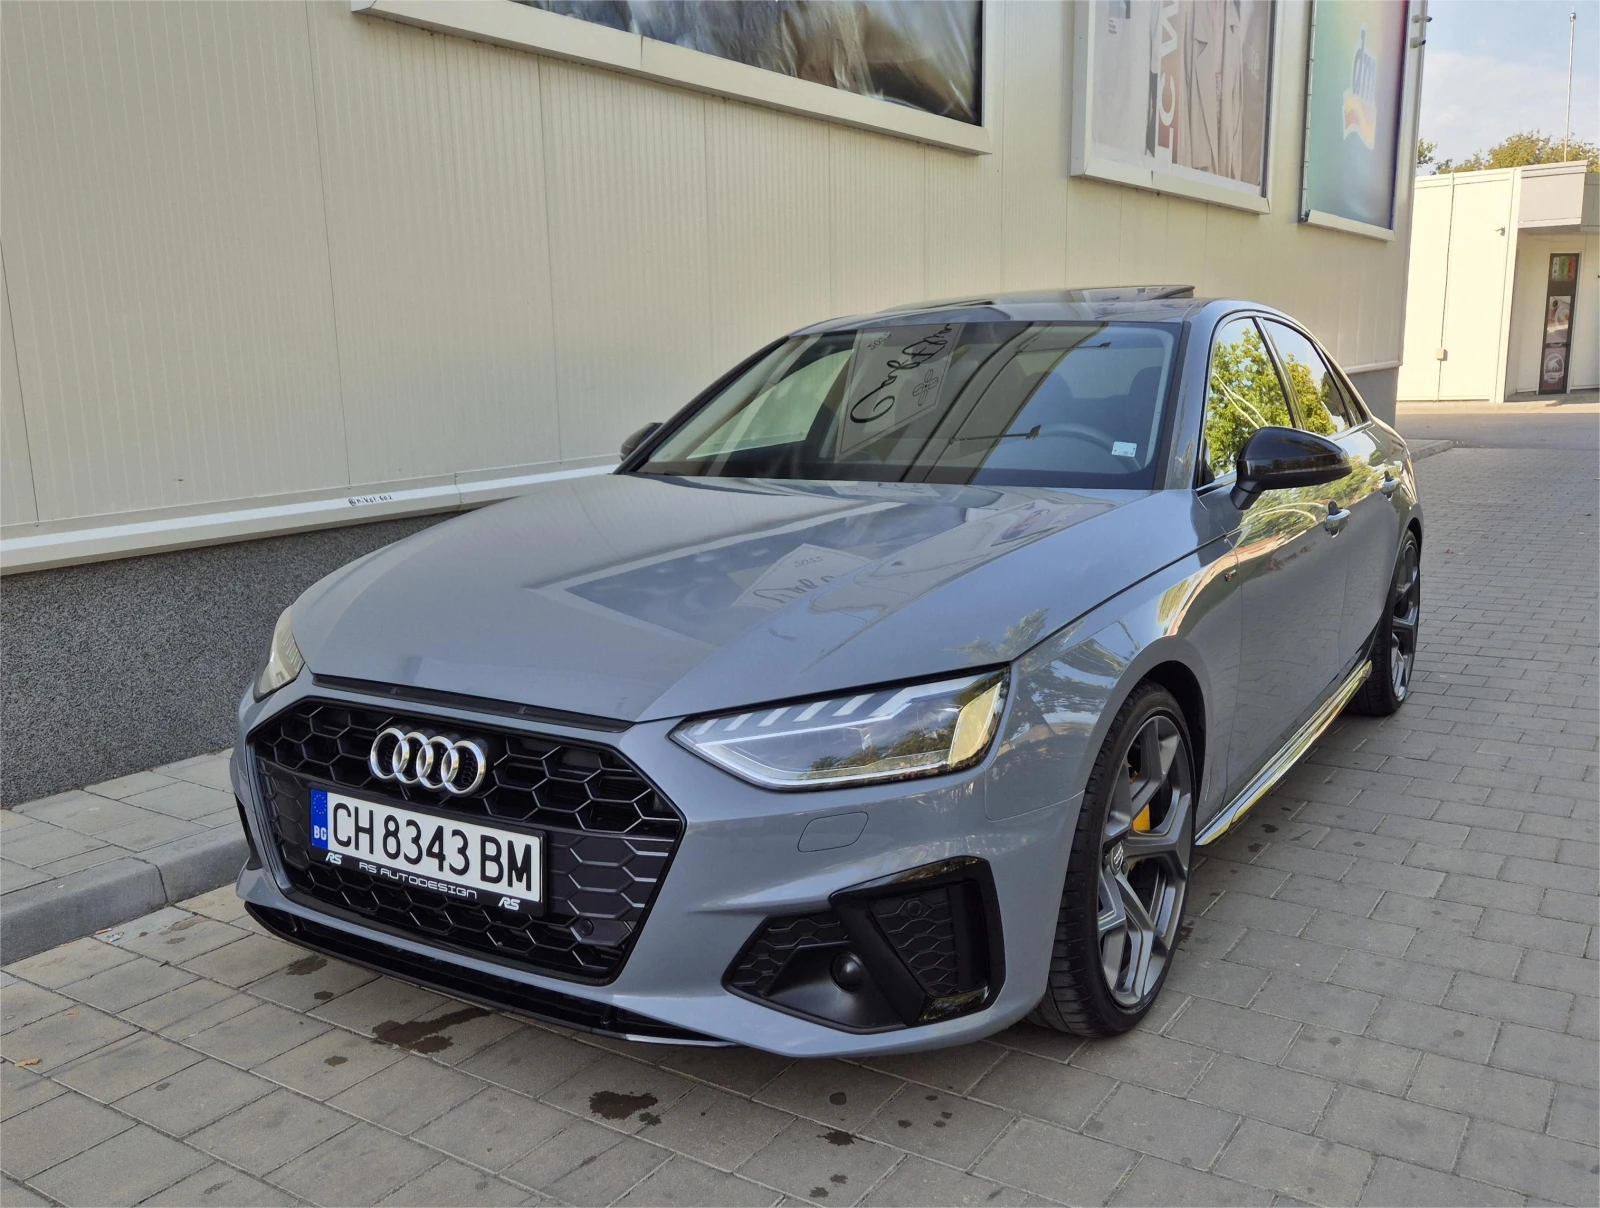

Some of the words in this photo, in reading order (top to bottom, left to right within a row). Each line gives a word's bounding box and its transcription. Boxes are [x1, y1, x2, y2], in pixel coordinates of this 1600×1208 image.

[1351, 29, 1375, 103] dm
[313, 825, 327, 841] BG
[325, 851, 343, 865] RS
[333, 802, 374, 855] CH
[382, 814, 470, 876] 8343
[480, 833, 532, 892] BM
[358, 861, 378, 874] RS
[380, 867, 478, 900] AUTODESIGN
[498, 896, 521, 911] RS
